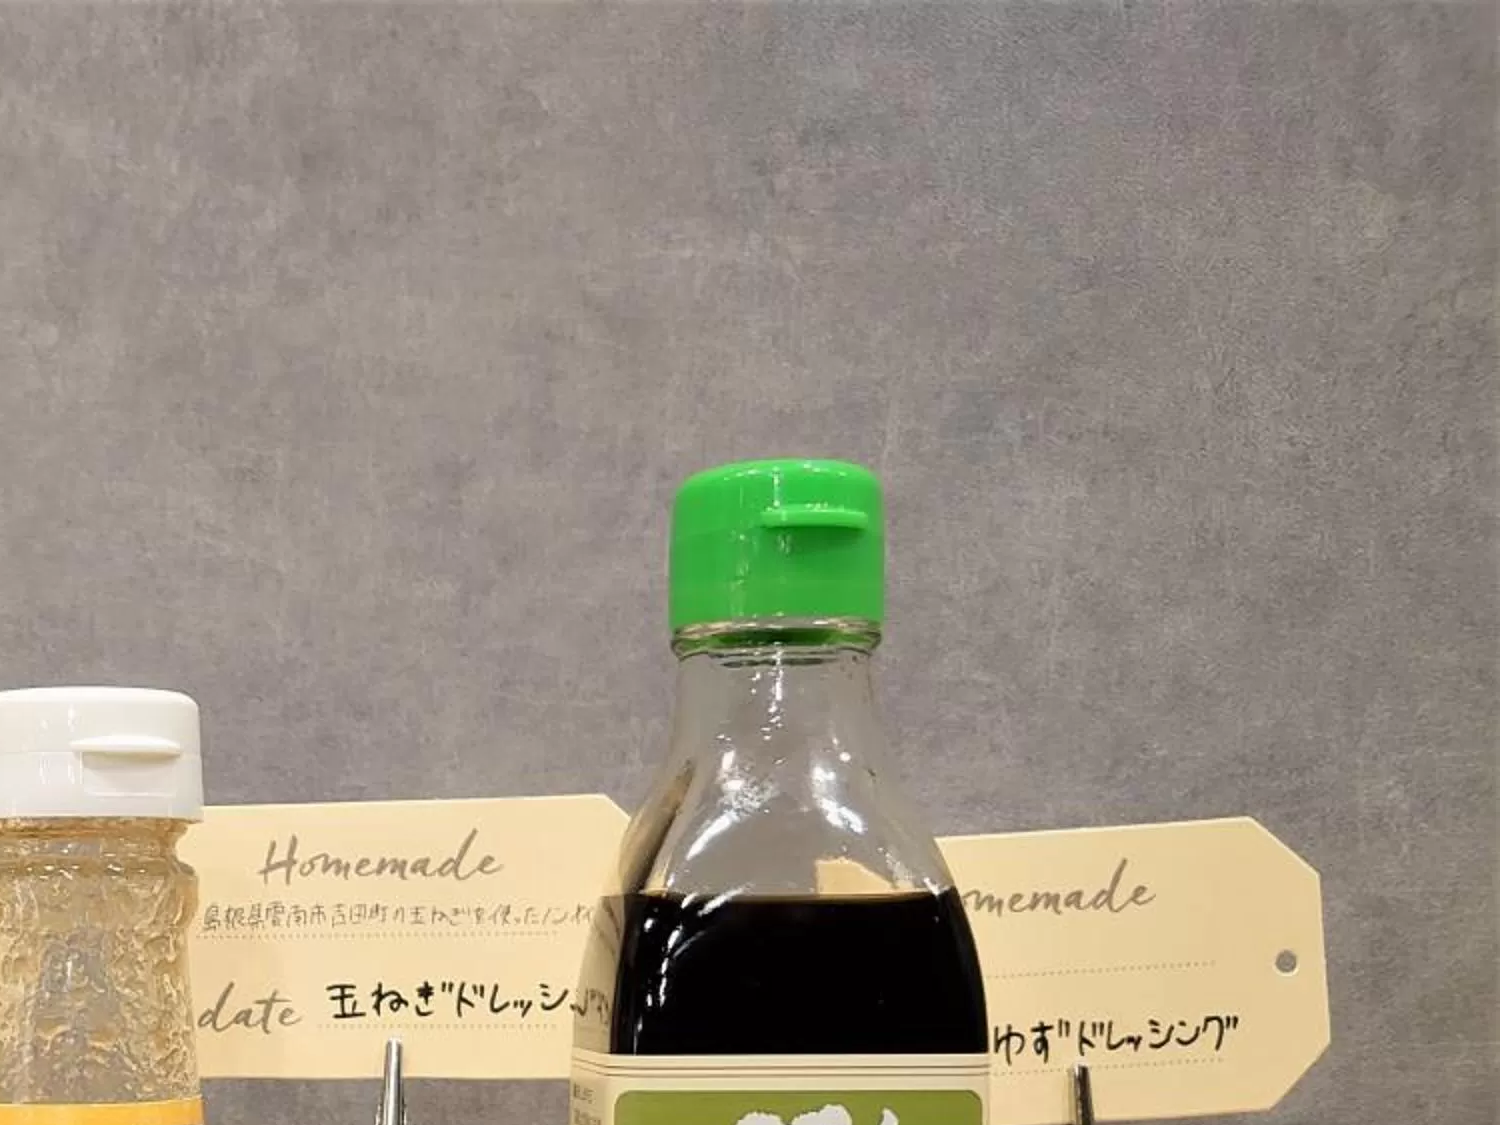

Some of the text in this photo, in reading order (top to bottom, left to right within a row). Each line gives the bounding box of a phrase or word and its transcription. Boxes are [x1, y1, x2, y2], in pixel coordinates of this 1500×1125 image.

[258, 828, 505, 885] Homemade
[962, 858, 1156, 917] memade
[198, 982, 303, 1034] date
[993, 1015, 1239, 1066] ゆずドレッシング
